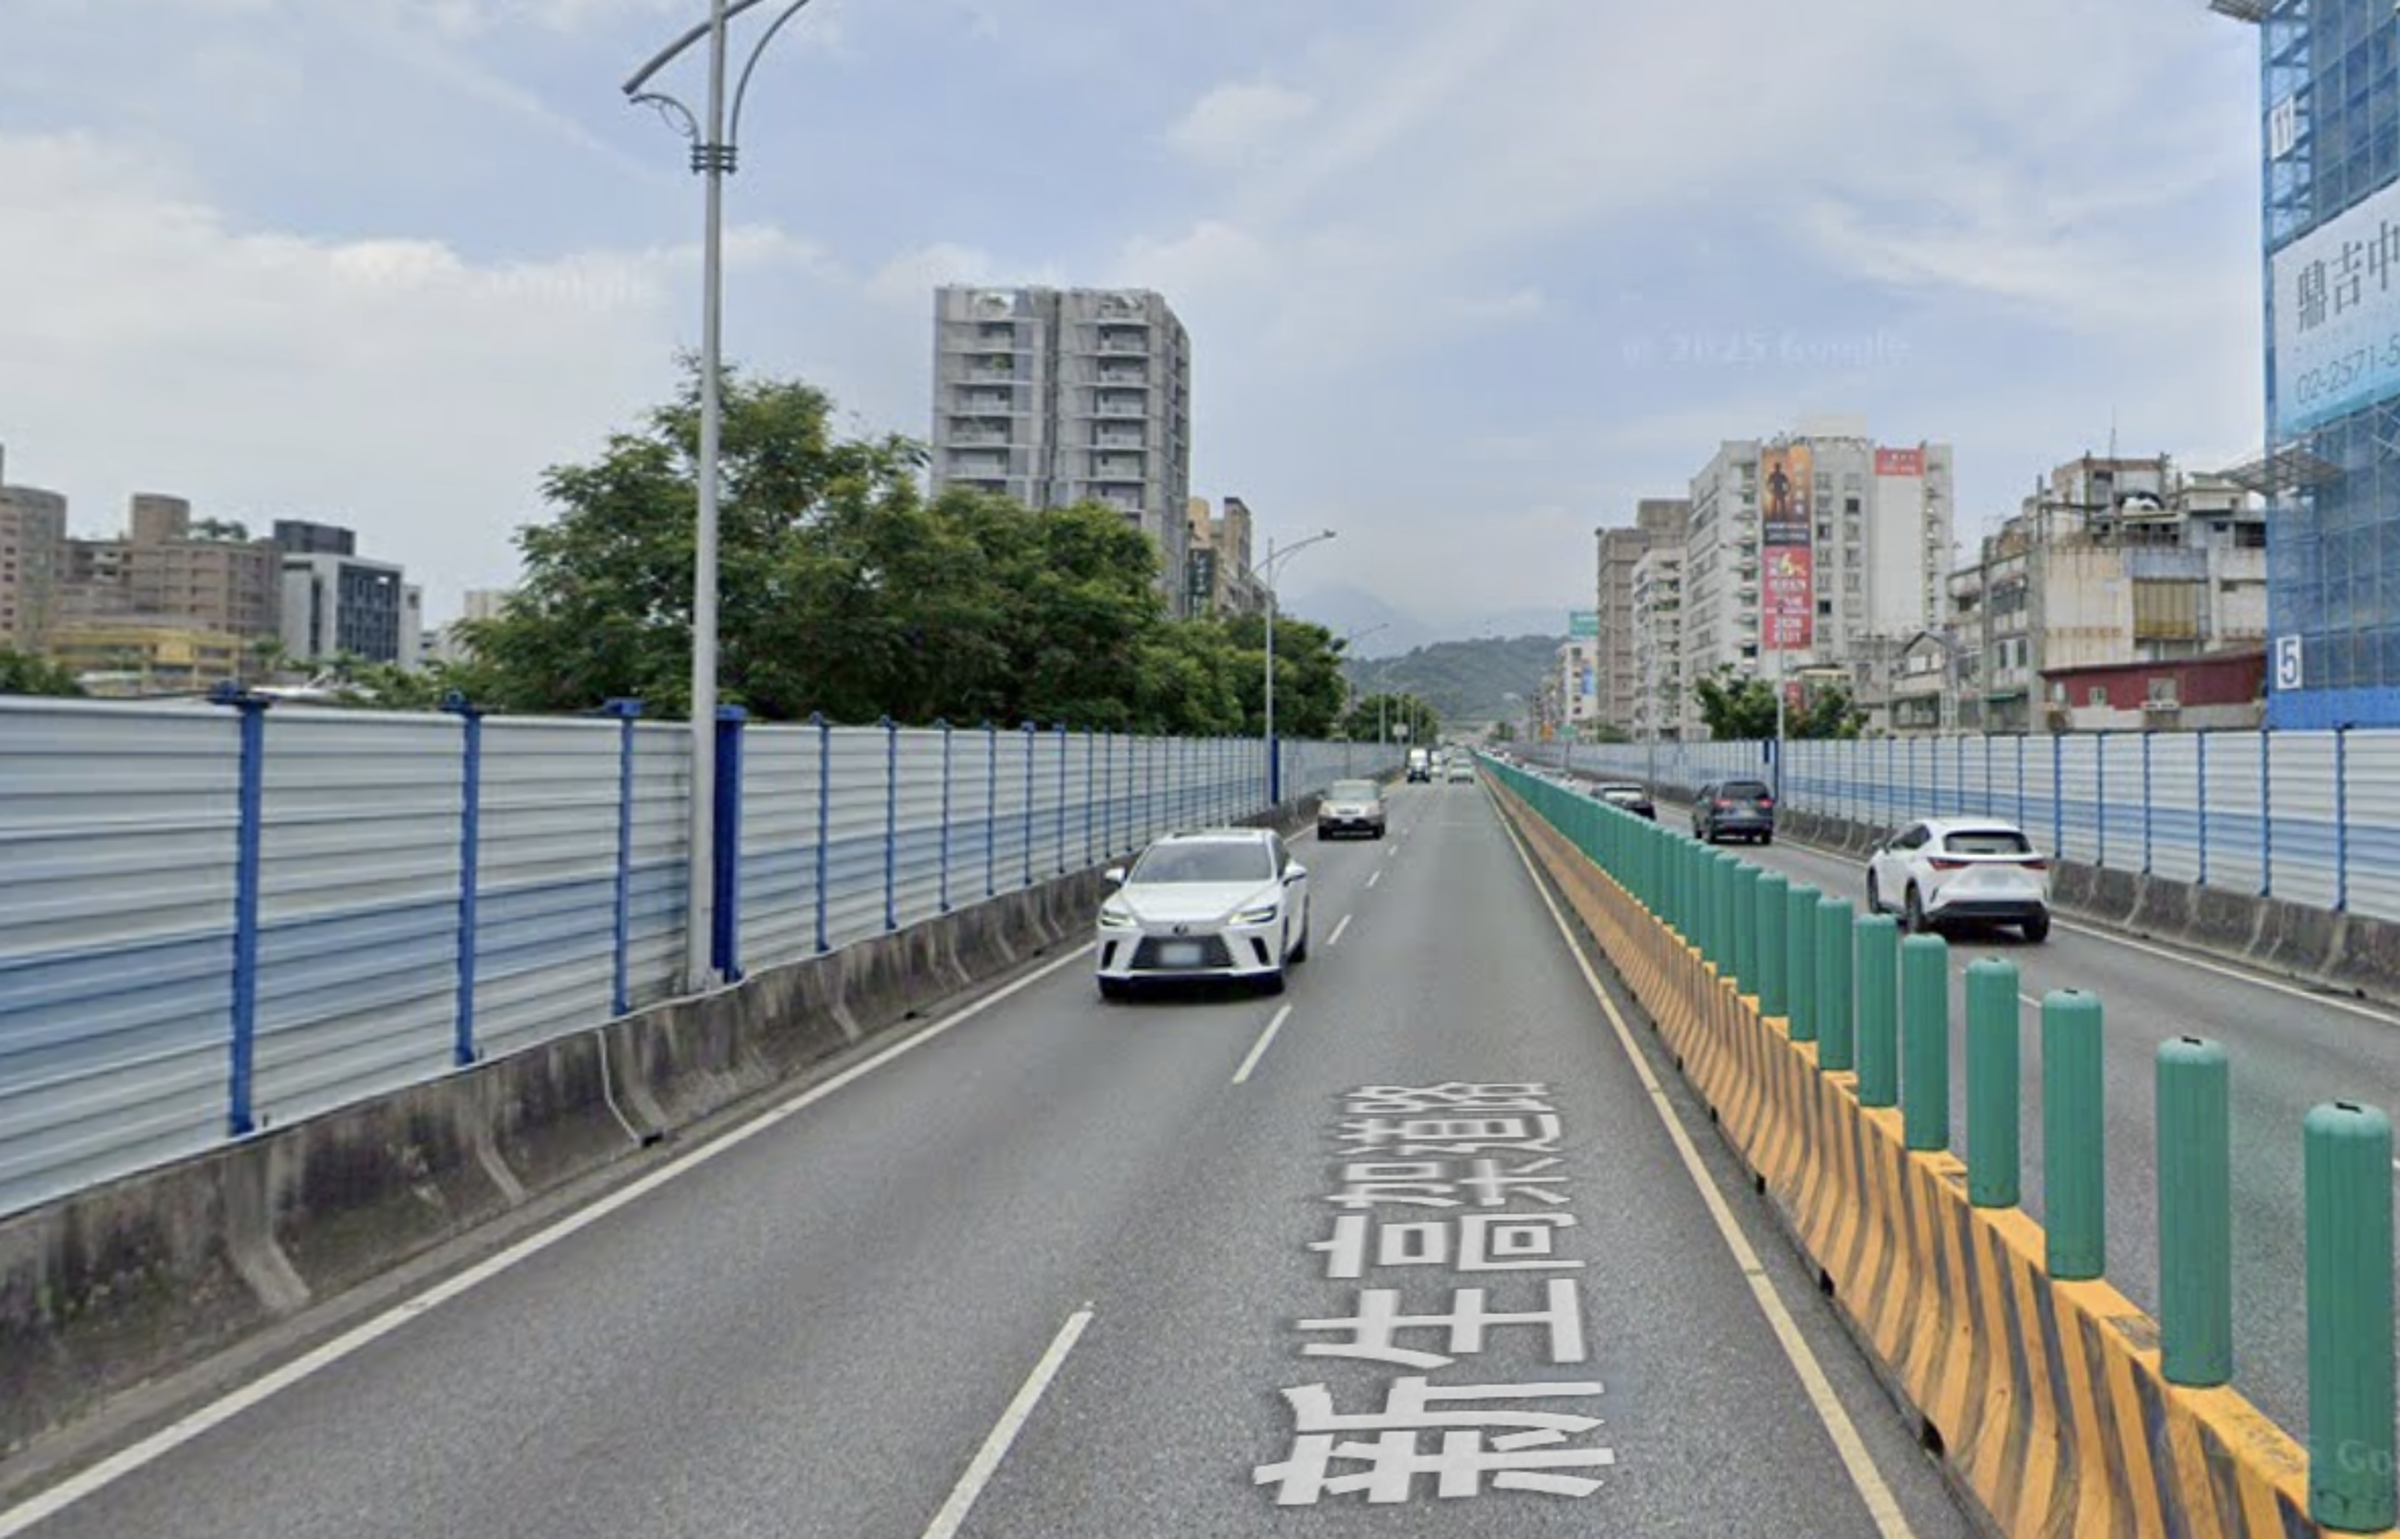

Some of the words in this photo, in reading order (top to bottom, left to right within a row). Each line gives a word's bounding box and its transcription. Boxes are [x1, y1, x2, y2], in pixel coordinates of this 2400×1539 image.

[2281, 640, 2297, 685] 5
[1252, 1081, 1616, 1506] 新生高架道路
